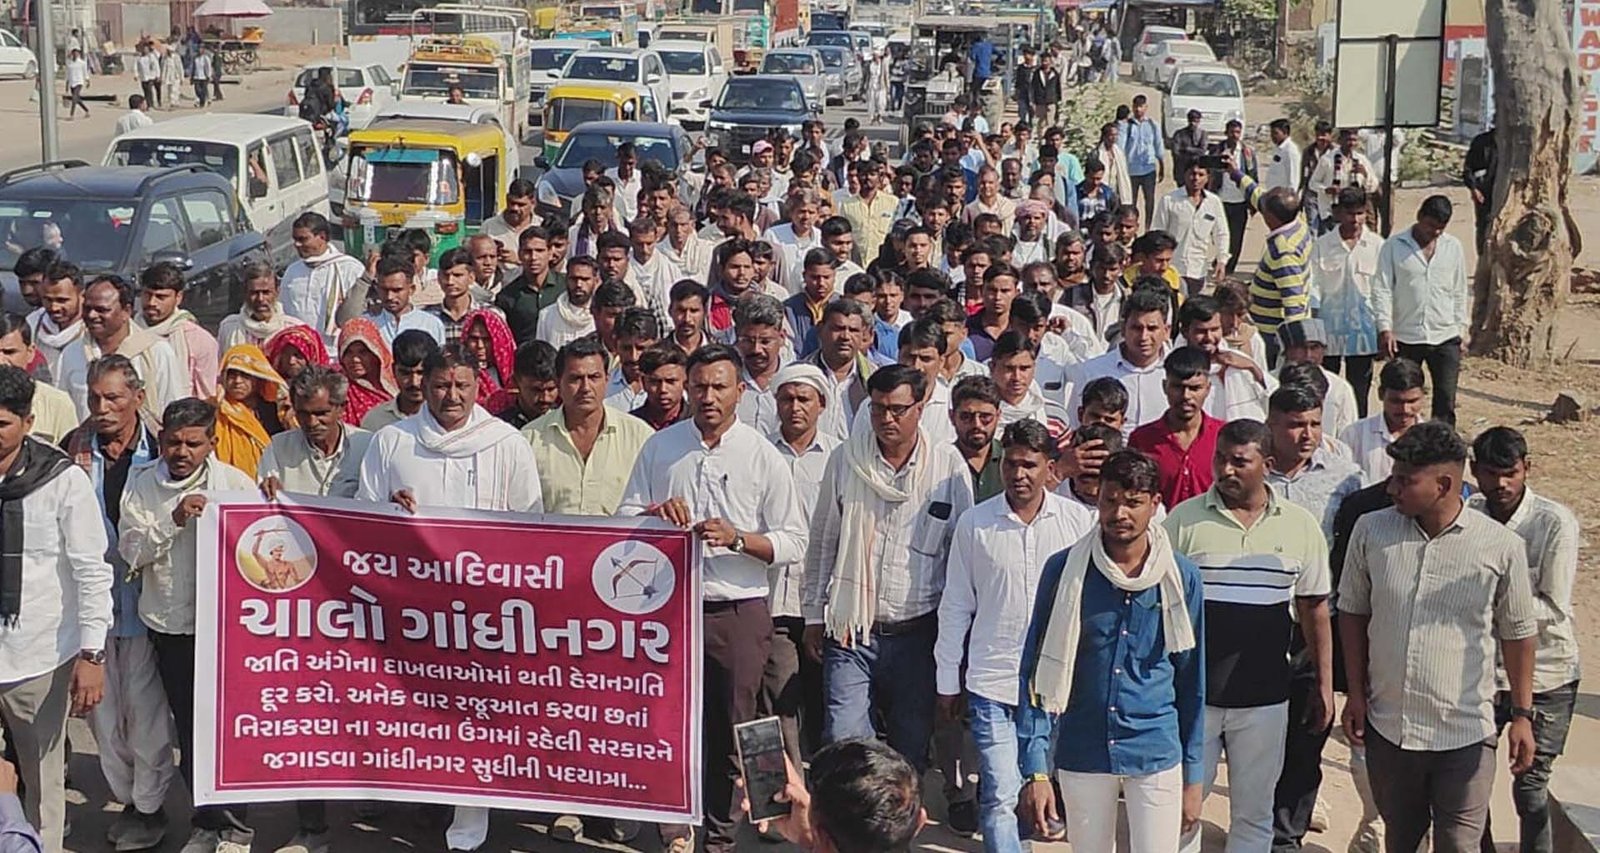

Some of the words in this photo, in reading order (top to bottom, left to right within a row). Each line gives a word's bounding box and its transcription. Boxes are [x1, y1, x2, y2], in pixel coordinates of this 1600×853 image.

[343, 550, 398, 578] જય
[407, 550, 565, 590] આદિવાસી
[239, 585, 386, 641] ચાલો
[401, 598, 670, 664] ગાંધીનગર
[244, 648, 299, 672] જાતિ
[306, 650, 377, 674] અંગેના
[383, 660, 512, 687] દાખલાઓમાં
[517, 665, 563, 688] થતી
[569, 667, 665, 697] હેરાનગતિ
[260, 687, 289, 713] દૂર
[347, 682, 407, 706] અનેક
[412, 692, 450, 709] વાર
[454, 695, 540, 721] રજૂઆત
[545, 700, 598, 723] કરવા
[604, 706, 649, 729] છતાં
[234, 713, 339, 738] નિરાકરણ
[345, 719, 369, 737] ના
[375, 720, 451, 740] આવતા
[526, 726, 582, 752] રહેલી
[588, 738, 674, 762] સરકારને
[262, 750, 356, 770] જગાડવા
[362, 747, 466, 773] ગાંધીનગર
[471, 754, 541, 783] સુધીની
